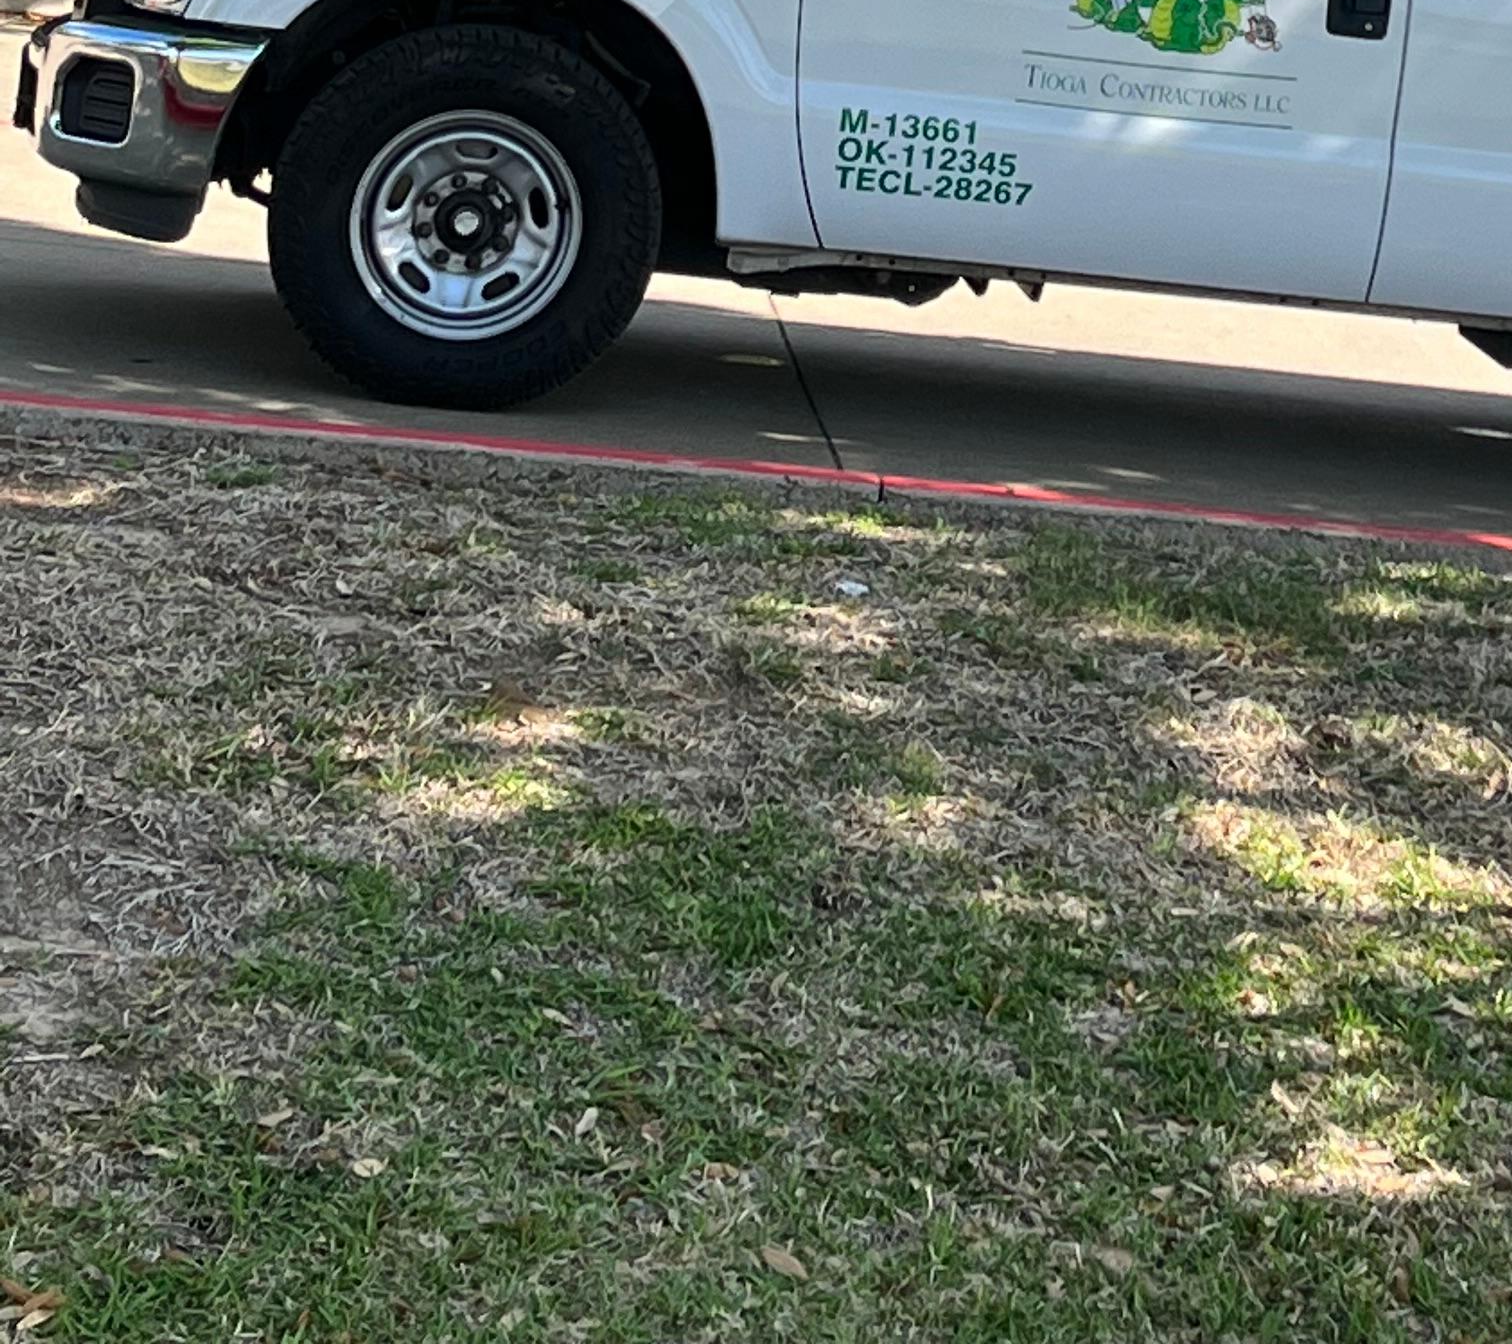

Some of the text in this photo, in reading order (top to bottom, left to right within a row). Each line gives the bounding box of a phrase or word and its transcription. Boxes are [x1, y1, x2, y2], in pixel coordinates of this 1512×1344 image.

[1023, 63, 1292, 114] TIOGA CONTRACTORS LLC
[839, 107, 978, 146] M-13661
[837, 138, 1018, 177] OK-112345
[834, 165, 1034, 206] TECL-28267
